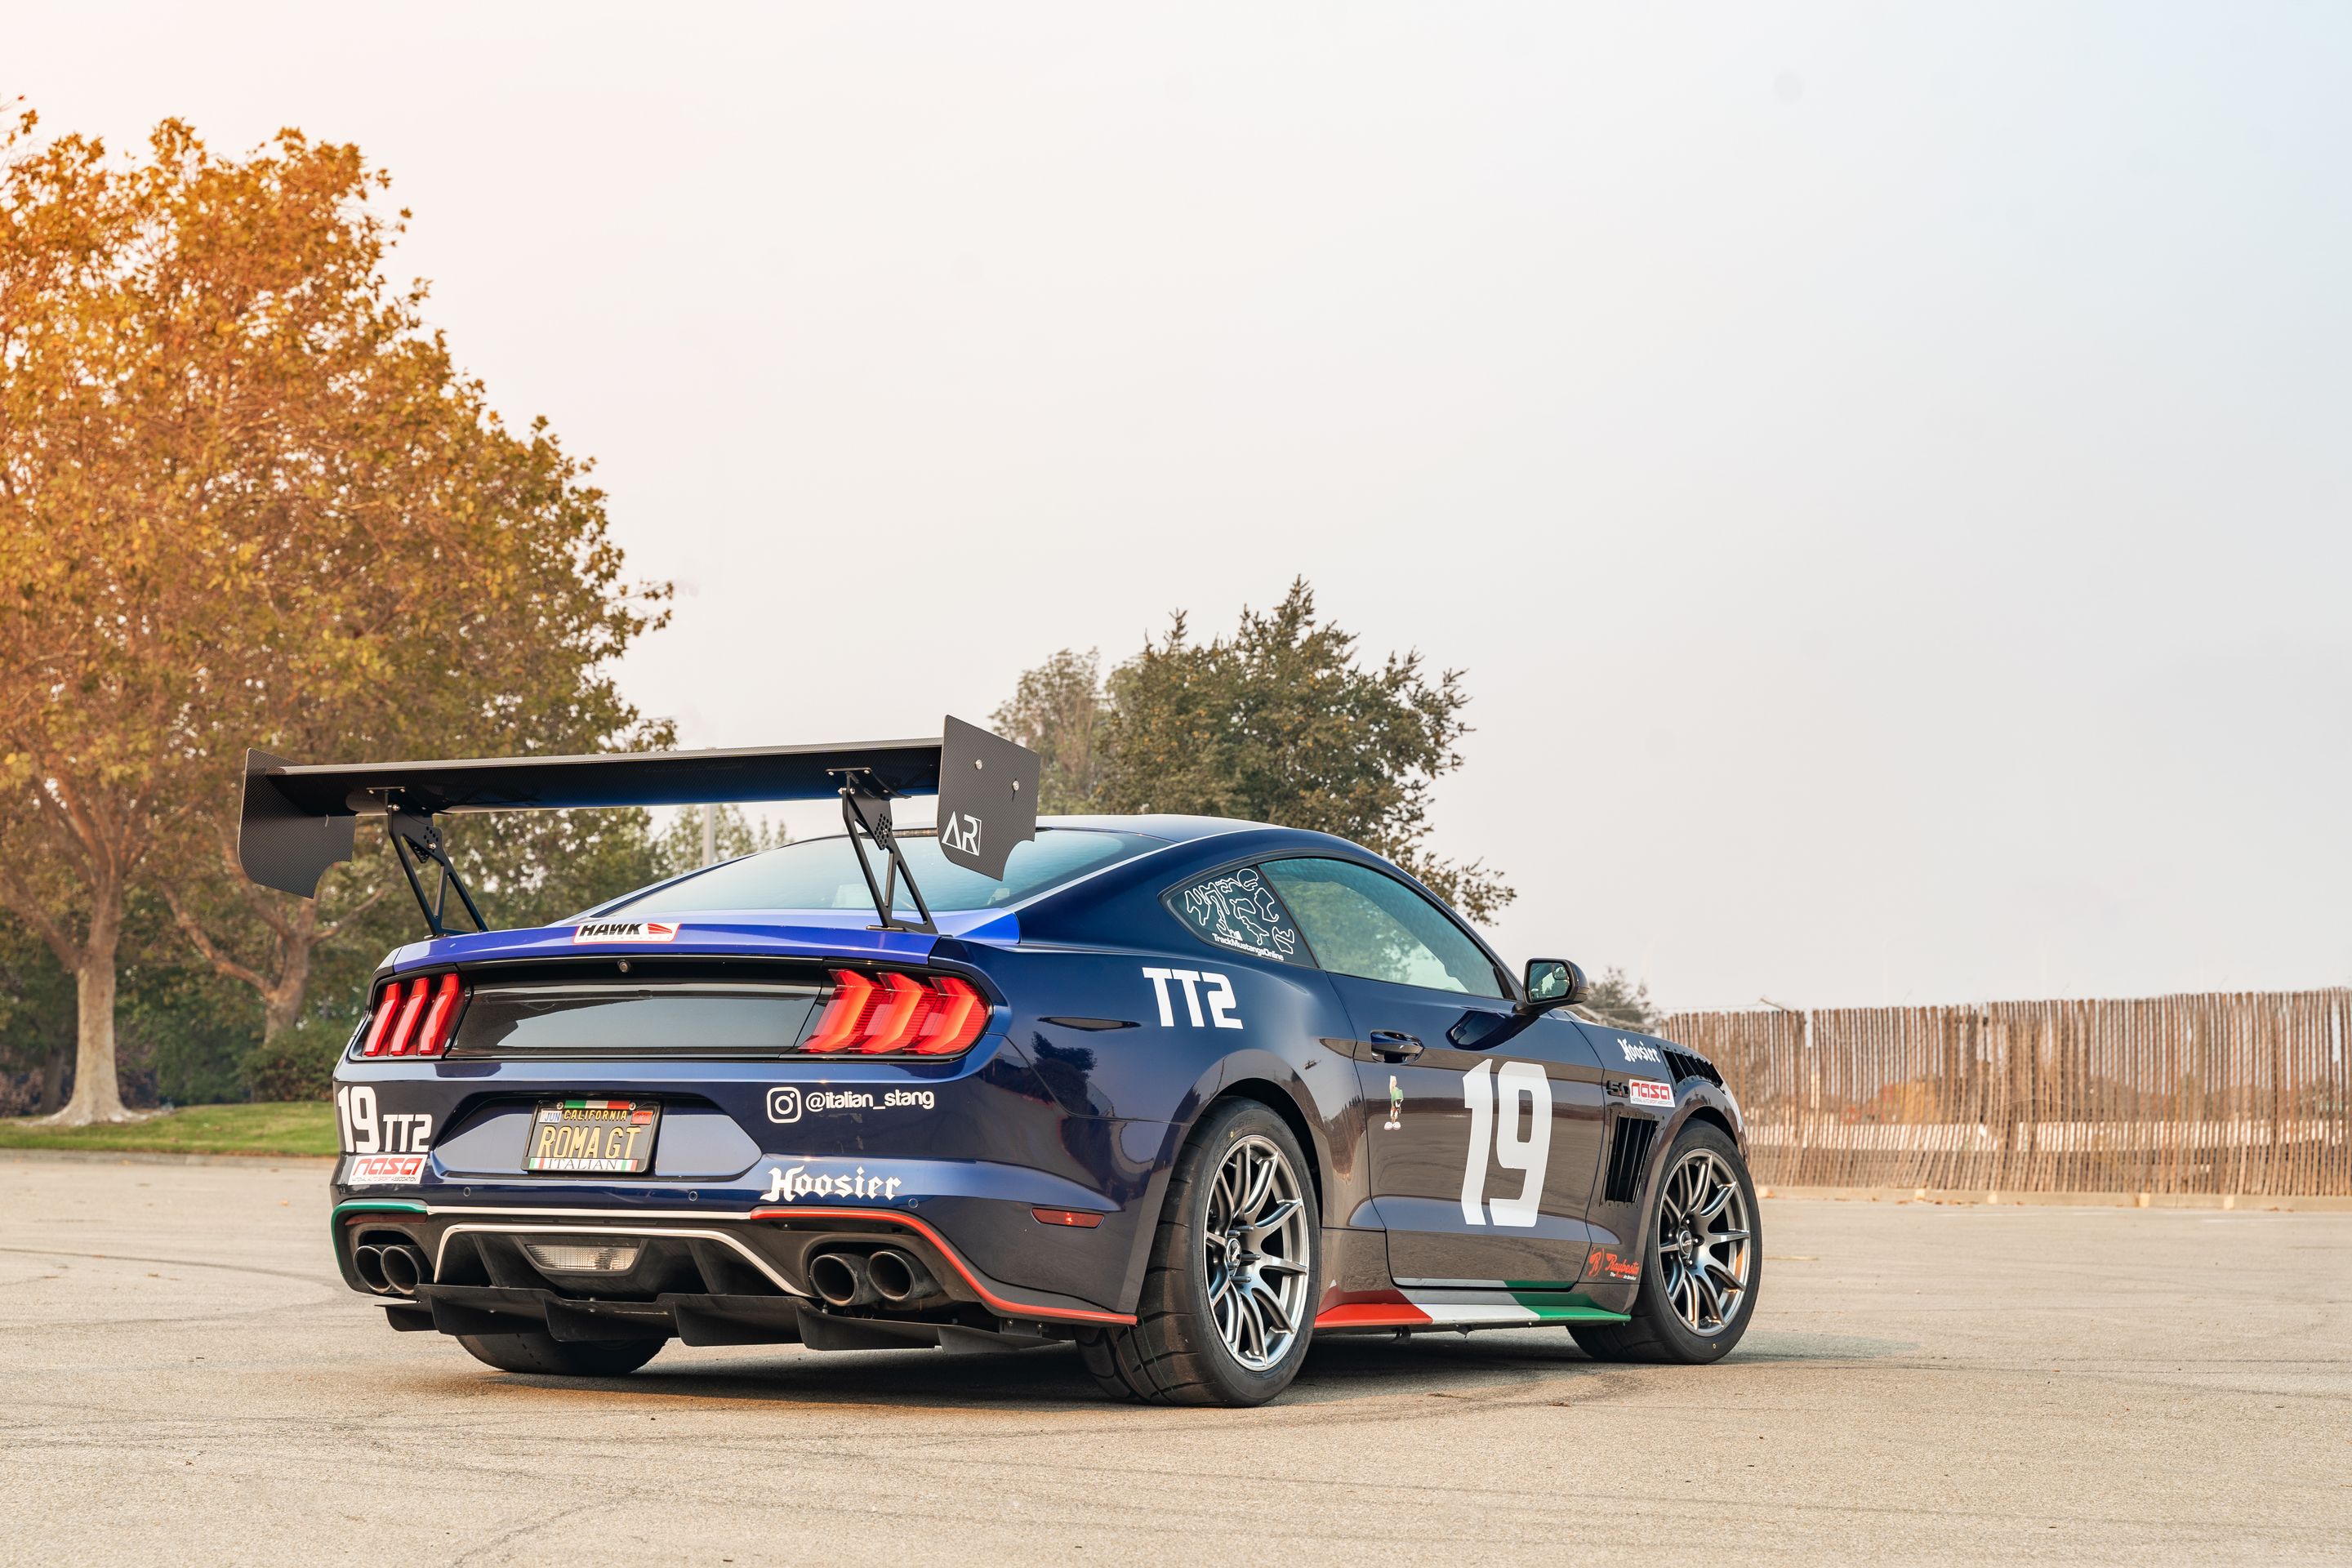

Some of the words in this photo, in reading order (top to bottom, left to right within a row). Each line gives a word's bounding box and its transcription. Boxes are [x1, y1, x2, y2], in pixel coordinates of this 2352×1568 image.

[942, 811, 982, 857] AR
[579, 924, 644, 937] HAWK
[1212, 933, 1285, 961] TrackMustangsOnline
[1142, 967, 1244, 1030] TT2
[1617, 1038, 1661, 1063] Hoosier
[564, 1110, 628, 1121] CALIFORNIA
[805, 1089, 935, 1112] @italian_stang
[337, 1085, 381, 1154] 19
[544, 1113, 560, 1122] JUN
[382, 1114, 432, 1152] TT2
[537, 1126, 601, 1159] ROMA
[604, 1127, 641, 1159] GT
[1461, 1058, 1552, 1227] 19
[548, 1158, 617, 1170] ITALIAN
[760, 1165, 902, 1202] Hoosier
